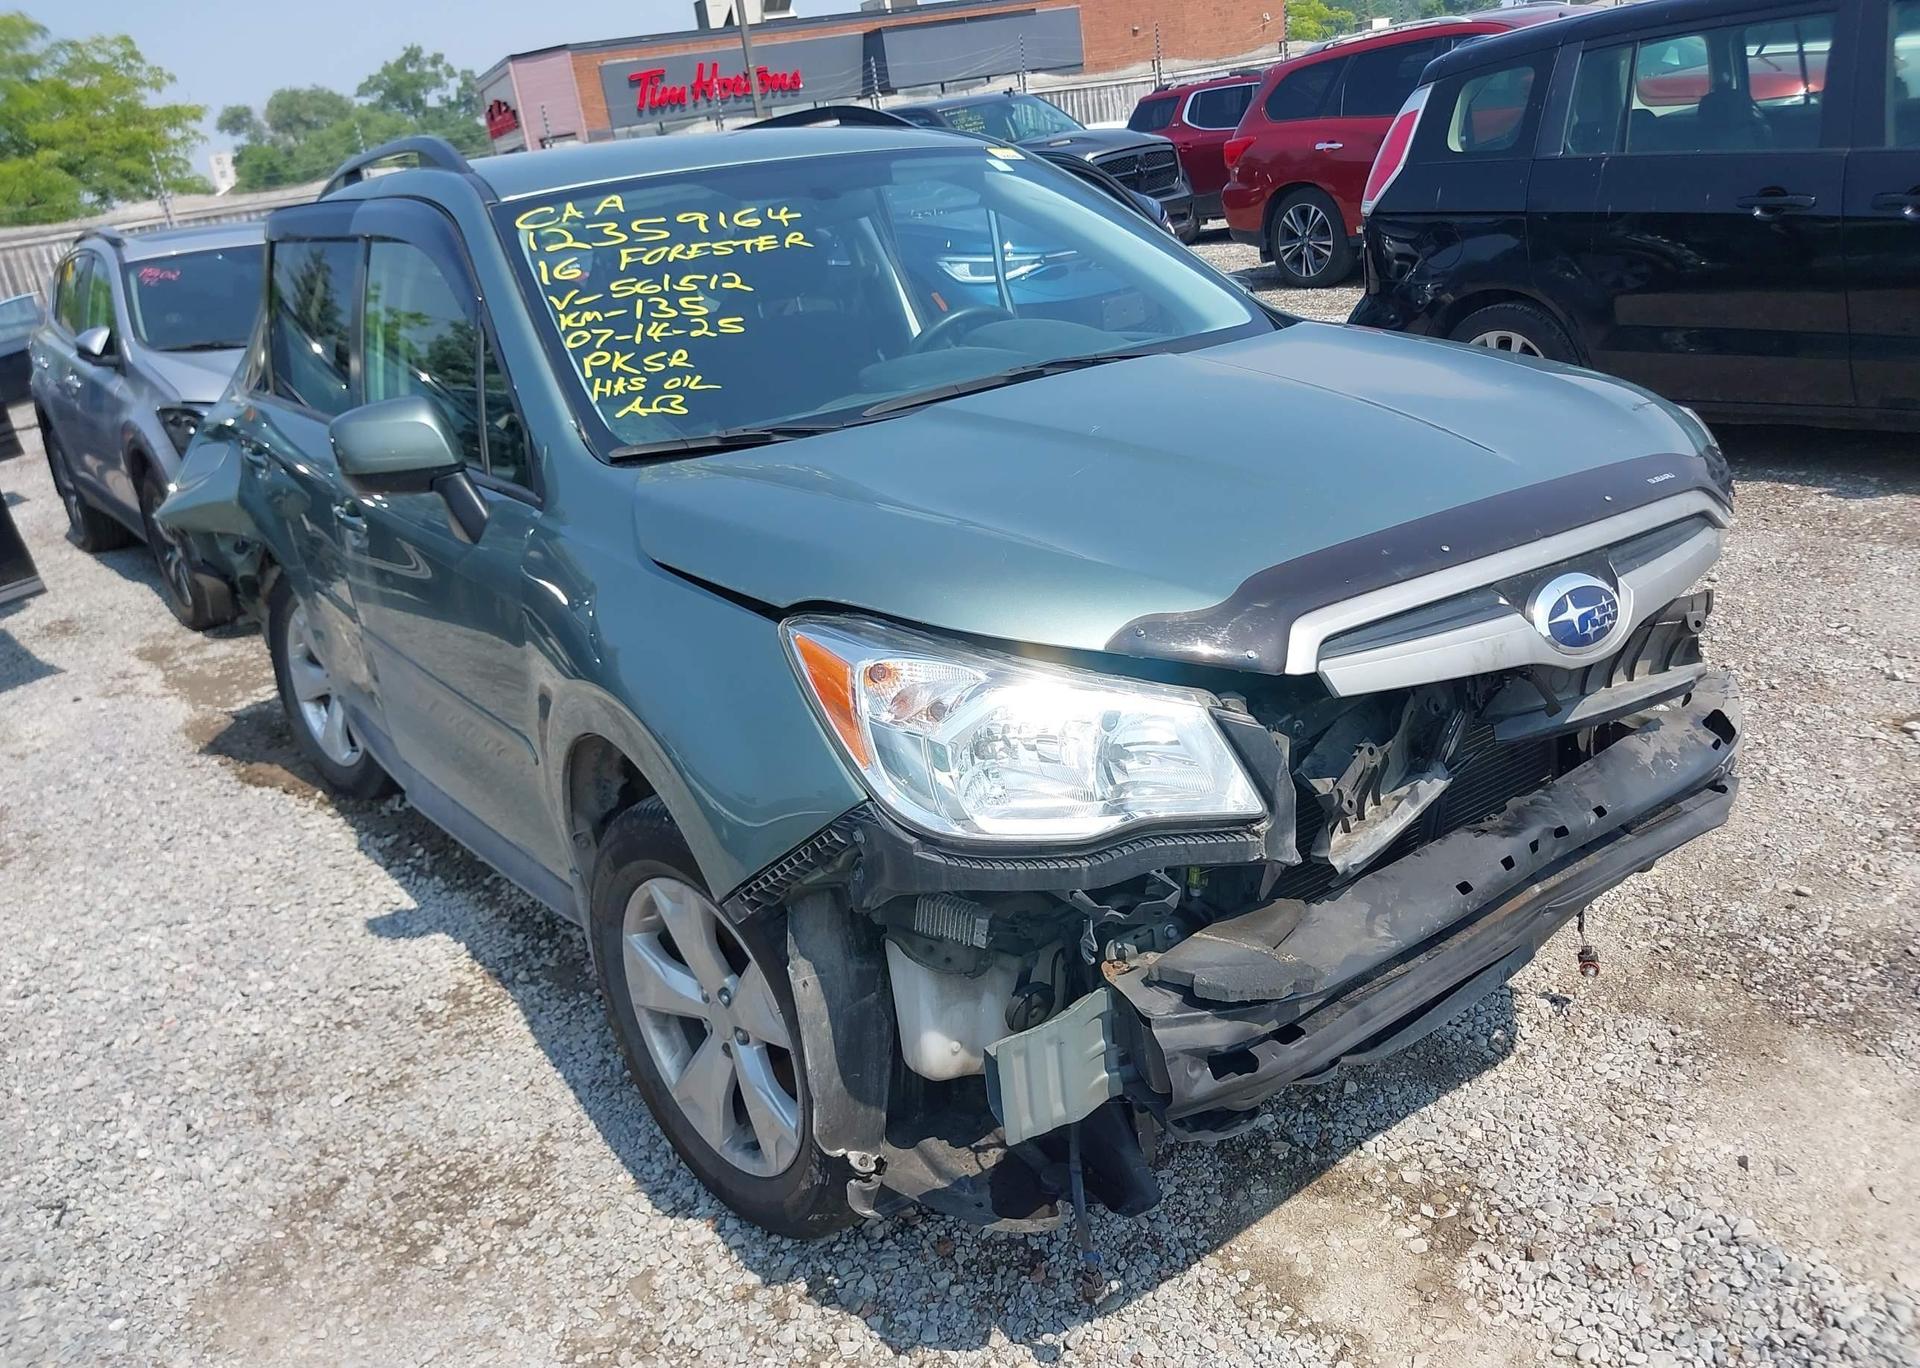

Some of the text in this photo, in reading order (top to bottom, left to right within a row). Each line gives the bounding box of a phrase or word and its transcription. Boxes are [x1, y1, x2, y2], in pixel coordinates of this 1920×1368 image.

[628, 68, 687, 110] Tim
[528, 207, 802, 252] 12359164
[538, 231, 815, 285] 16 FORESTER
[565, 316, 745, 349] 07-14-25
[592, 374, 722, 404] HAS OIL
